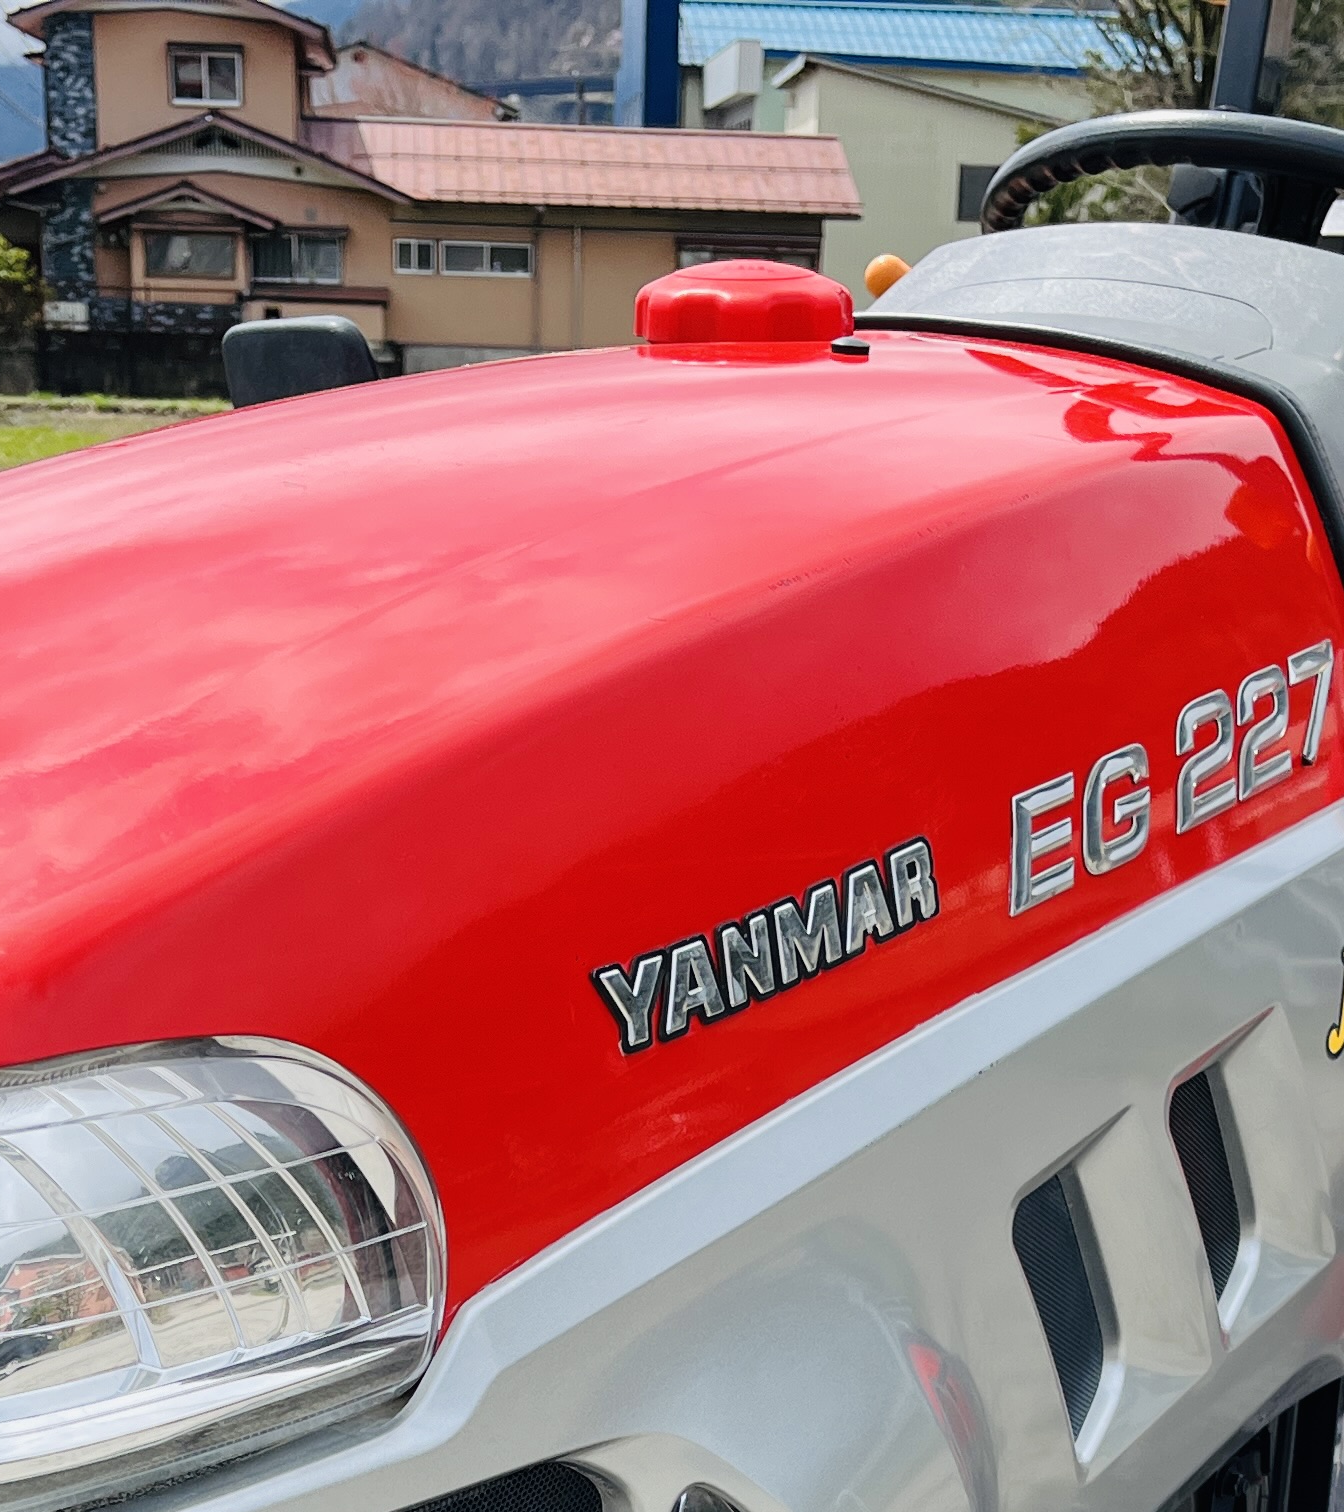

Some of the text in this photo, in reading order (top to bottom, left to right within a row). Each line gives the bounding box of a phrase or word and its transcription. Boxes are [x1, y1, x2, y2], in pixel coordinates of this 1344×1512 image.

[1009, 638, 1335, 918] EG 227
[594, 836, 940, 1054] YANMAR
